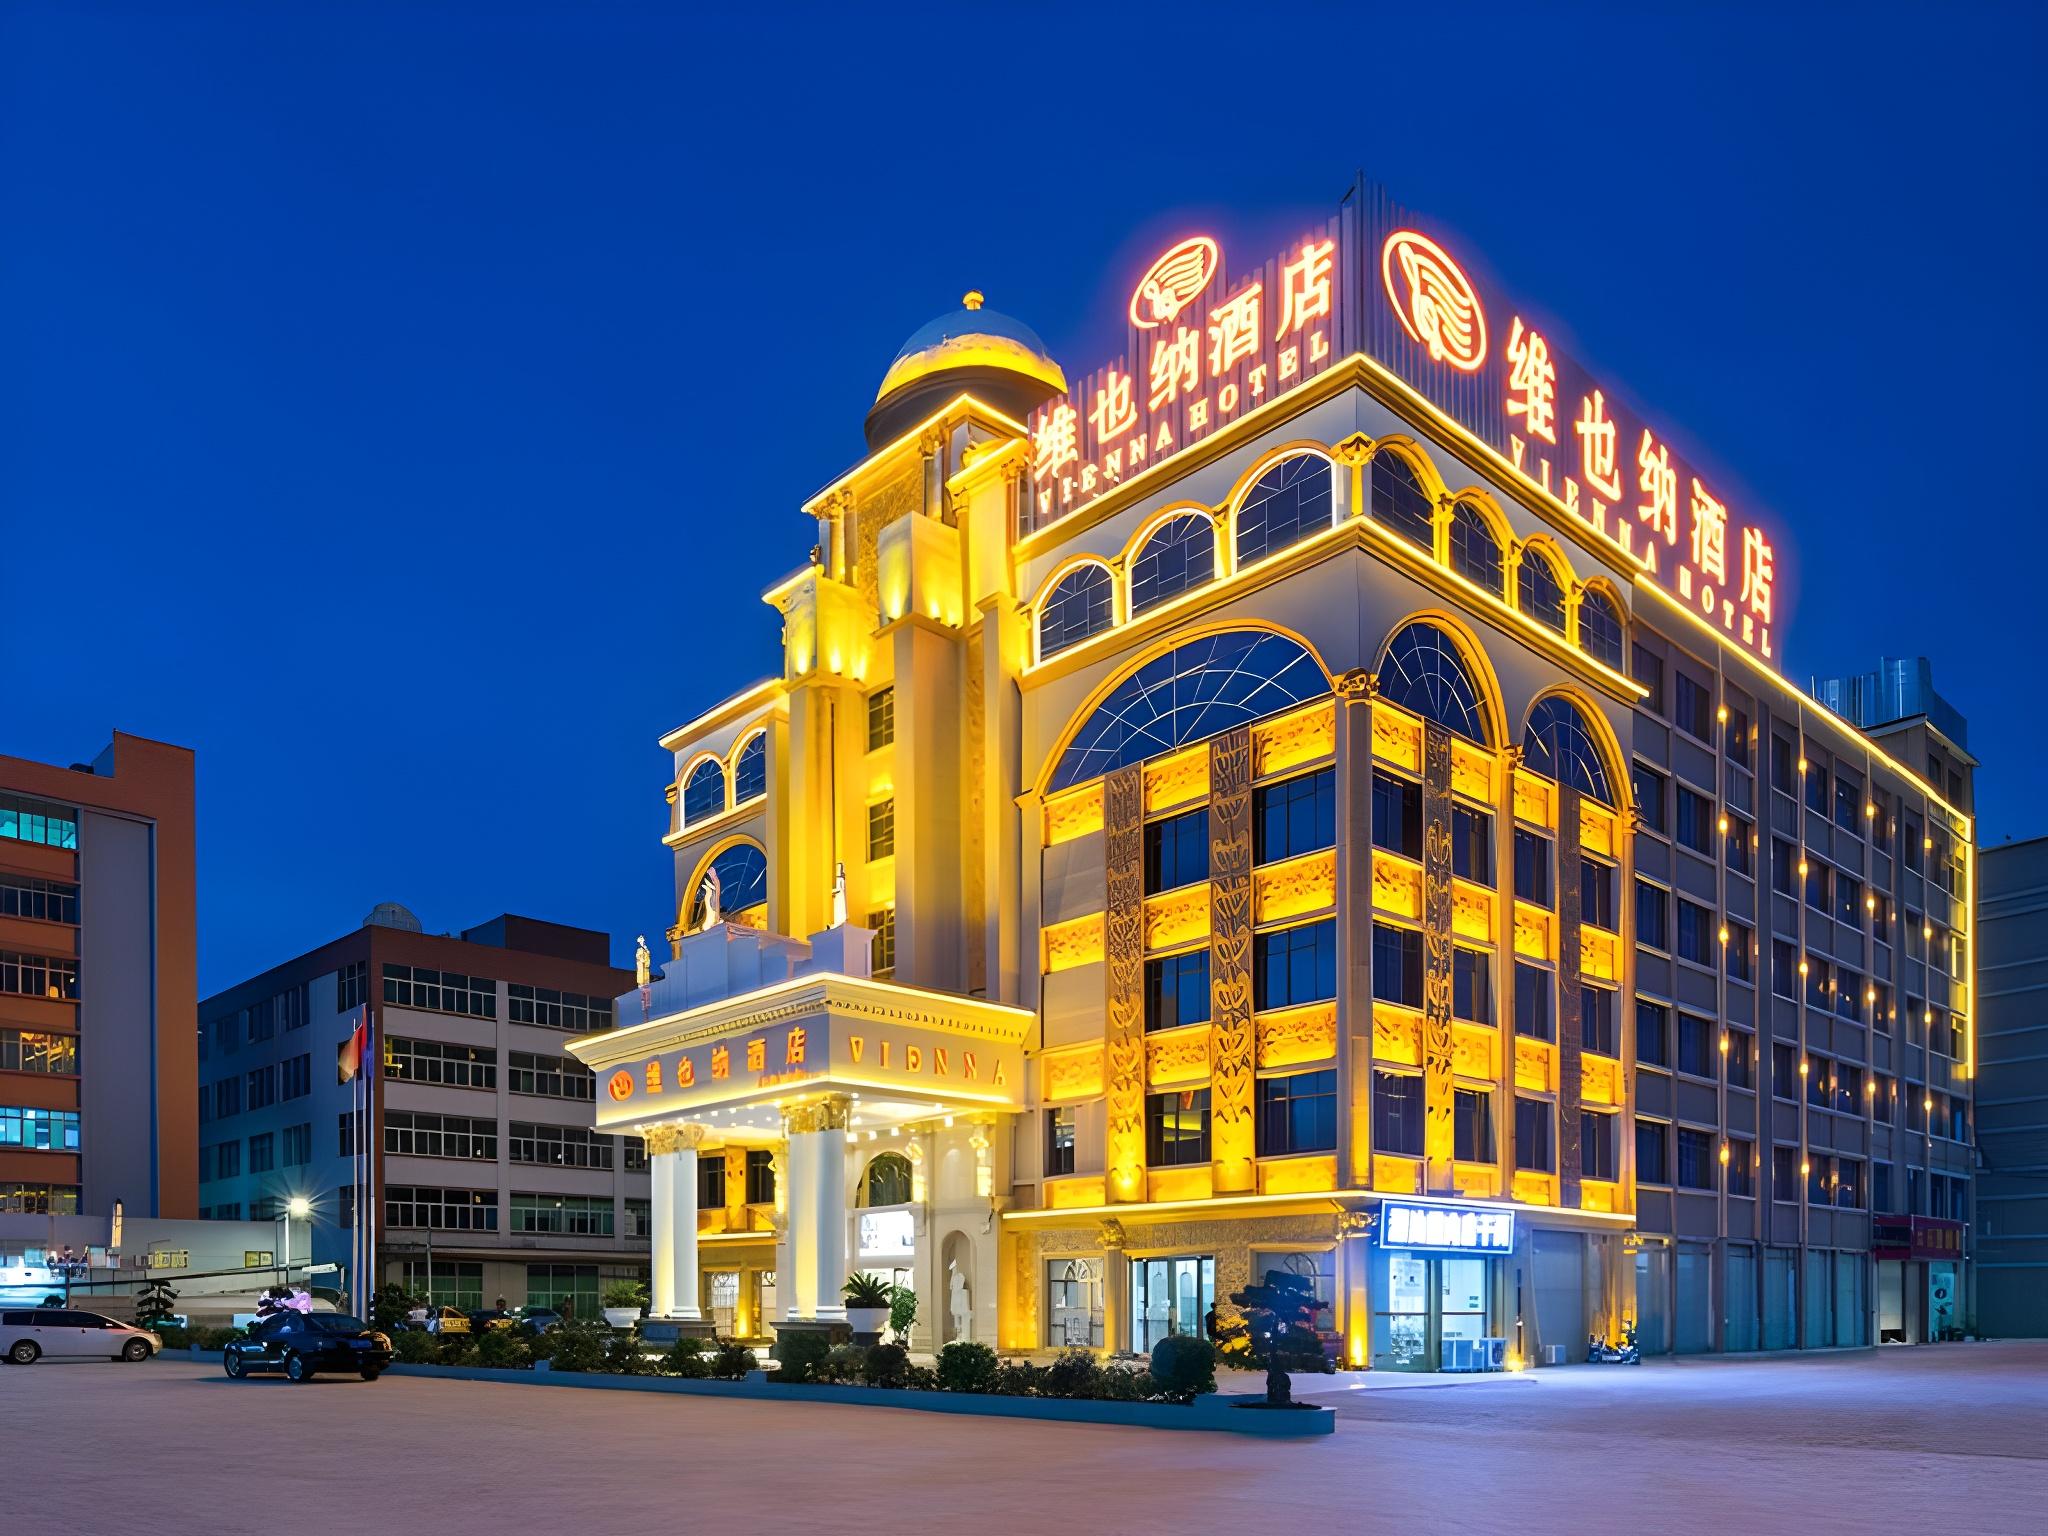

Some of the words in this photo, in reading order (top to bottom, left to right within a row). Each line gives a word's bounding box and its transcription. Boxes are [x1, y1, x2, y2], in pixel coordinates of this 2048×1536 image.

[1033, 239, 1335, 482] 维也纳酒店
[1188, 330, 1329, 432] HOTEL
[1506, 315, 1773, 625] 维也纳酒店
